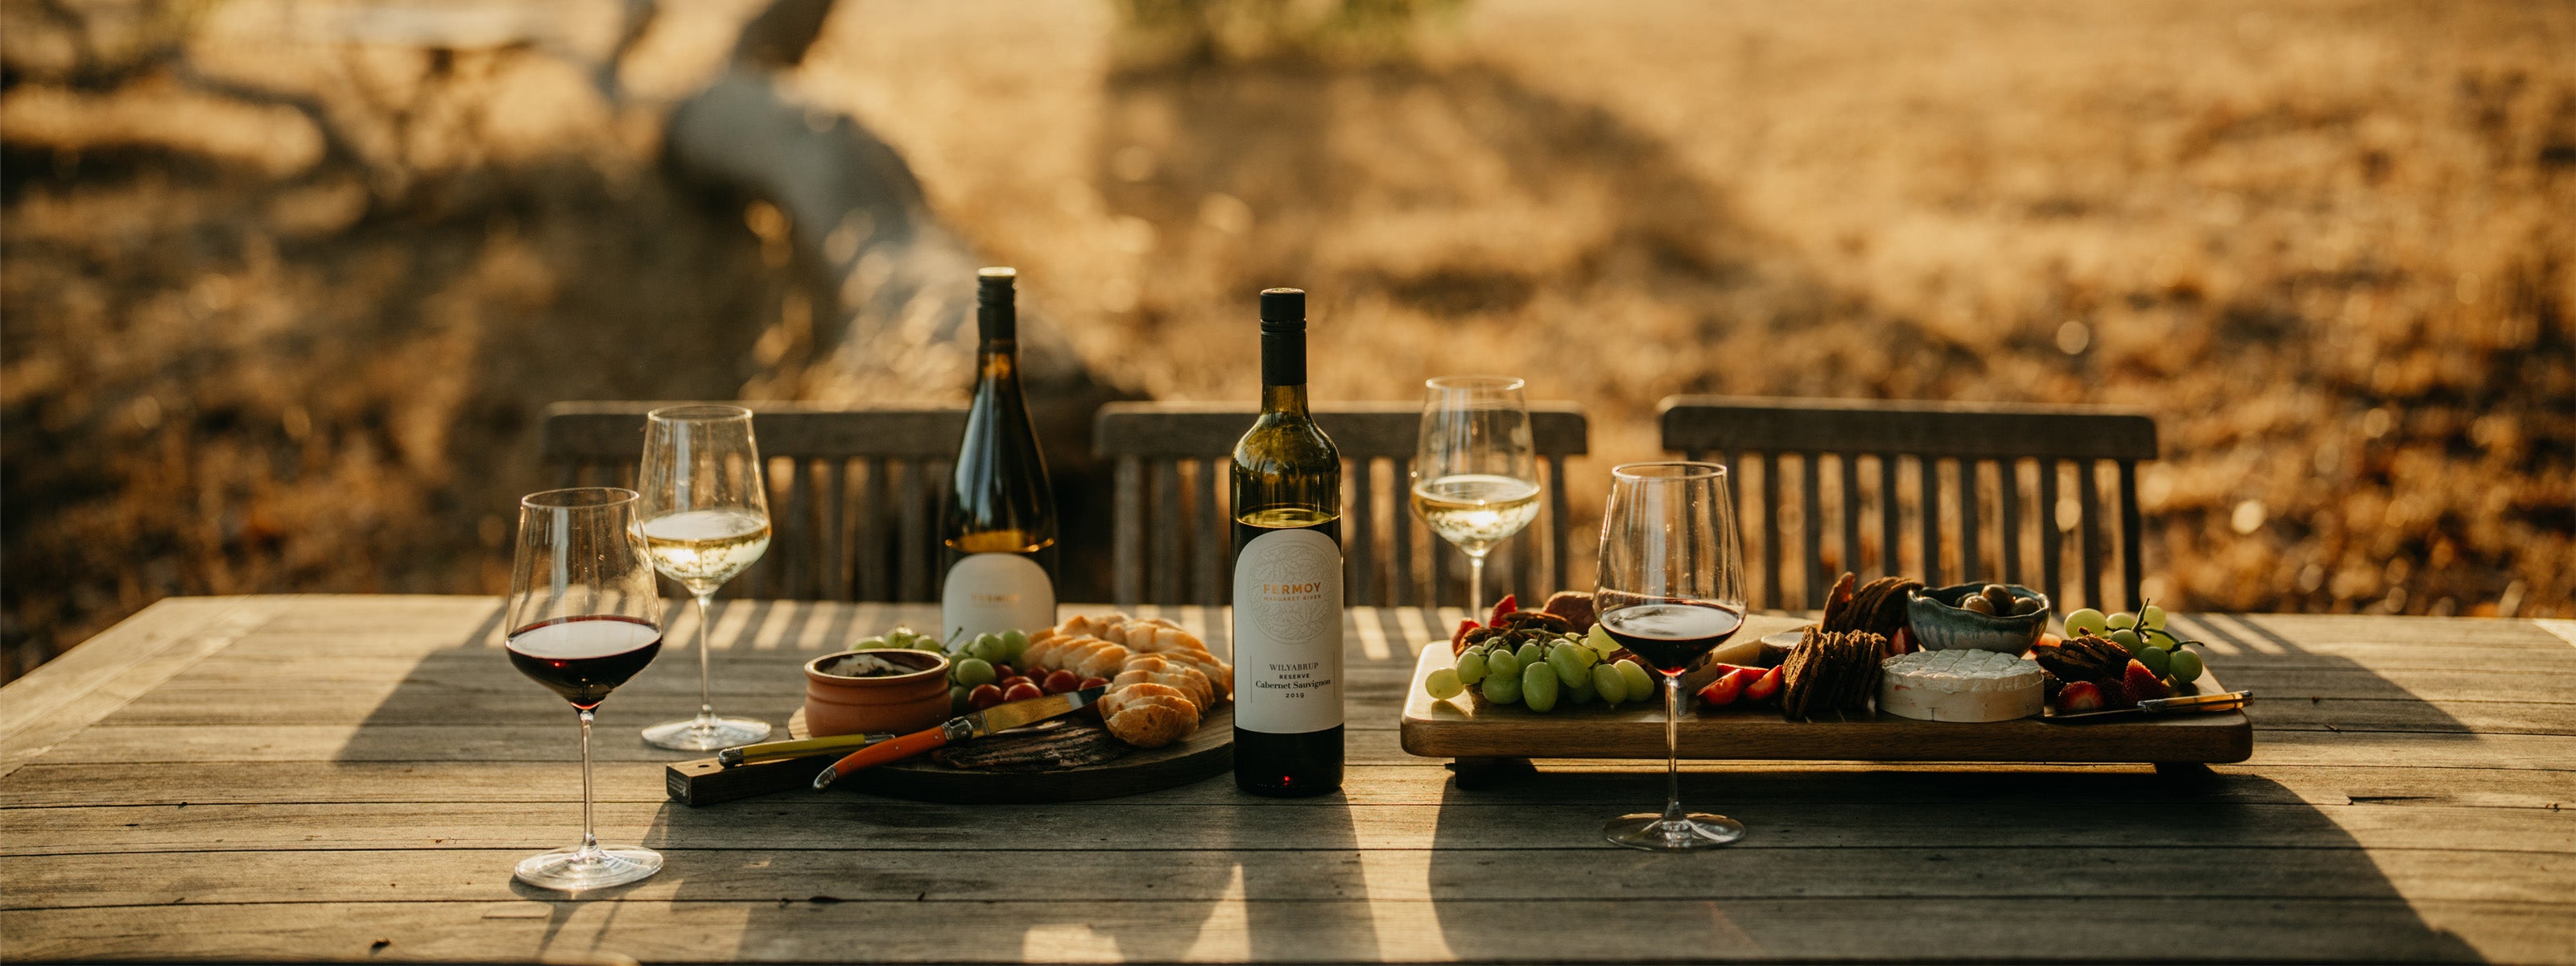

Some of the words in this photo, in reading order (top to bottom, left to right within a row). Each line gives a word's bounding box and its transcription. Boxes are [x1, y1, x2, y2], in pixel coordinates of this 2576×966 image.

[1263, 582, 1321, 594] FERMOY
[1269, 663, 1319, 671] WILYABRUP
[1256, 680, 1290, 689] Cabernet
[1293, 679, 1331, 689] Sauvignon
